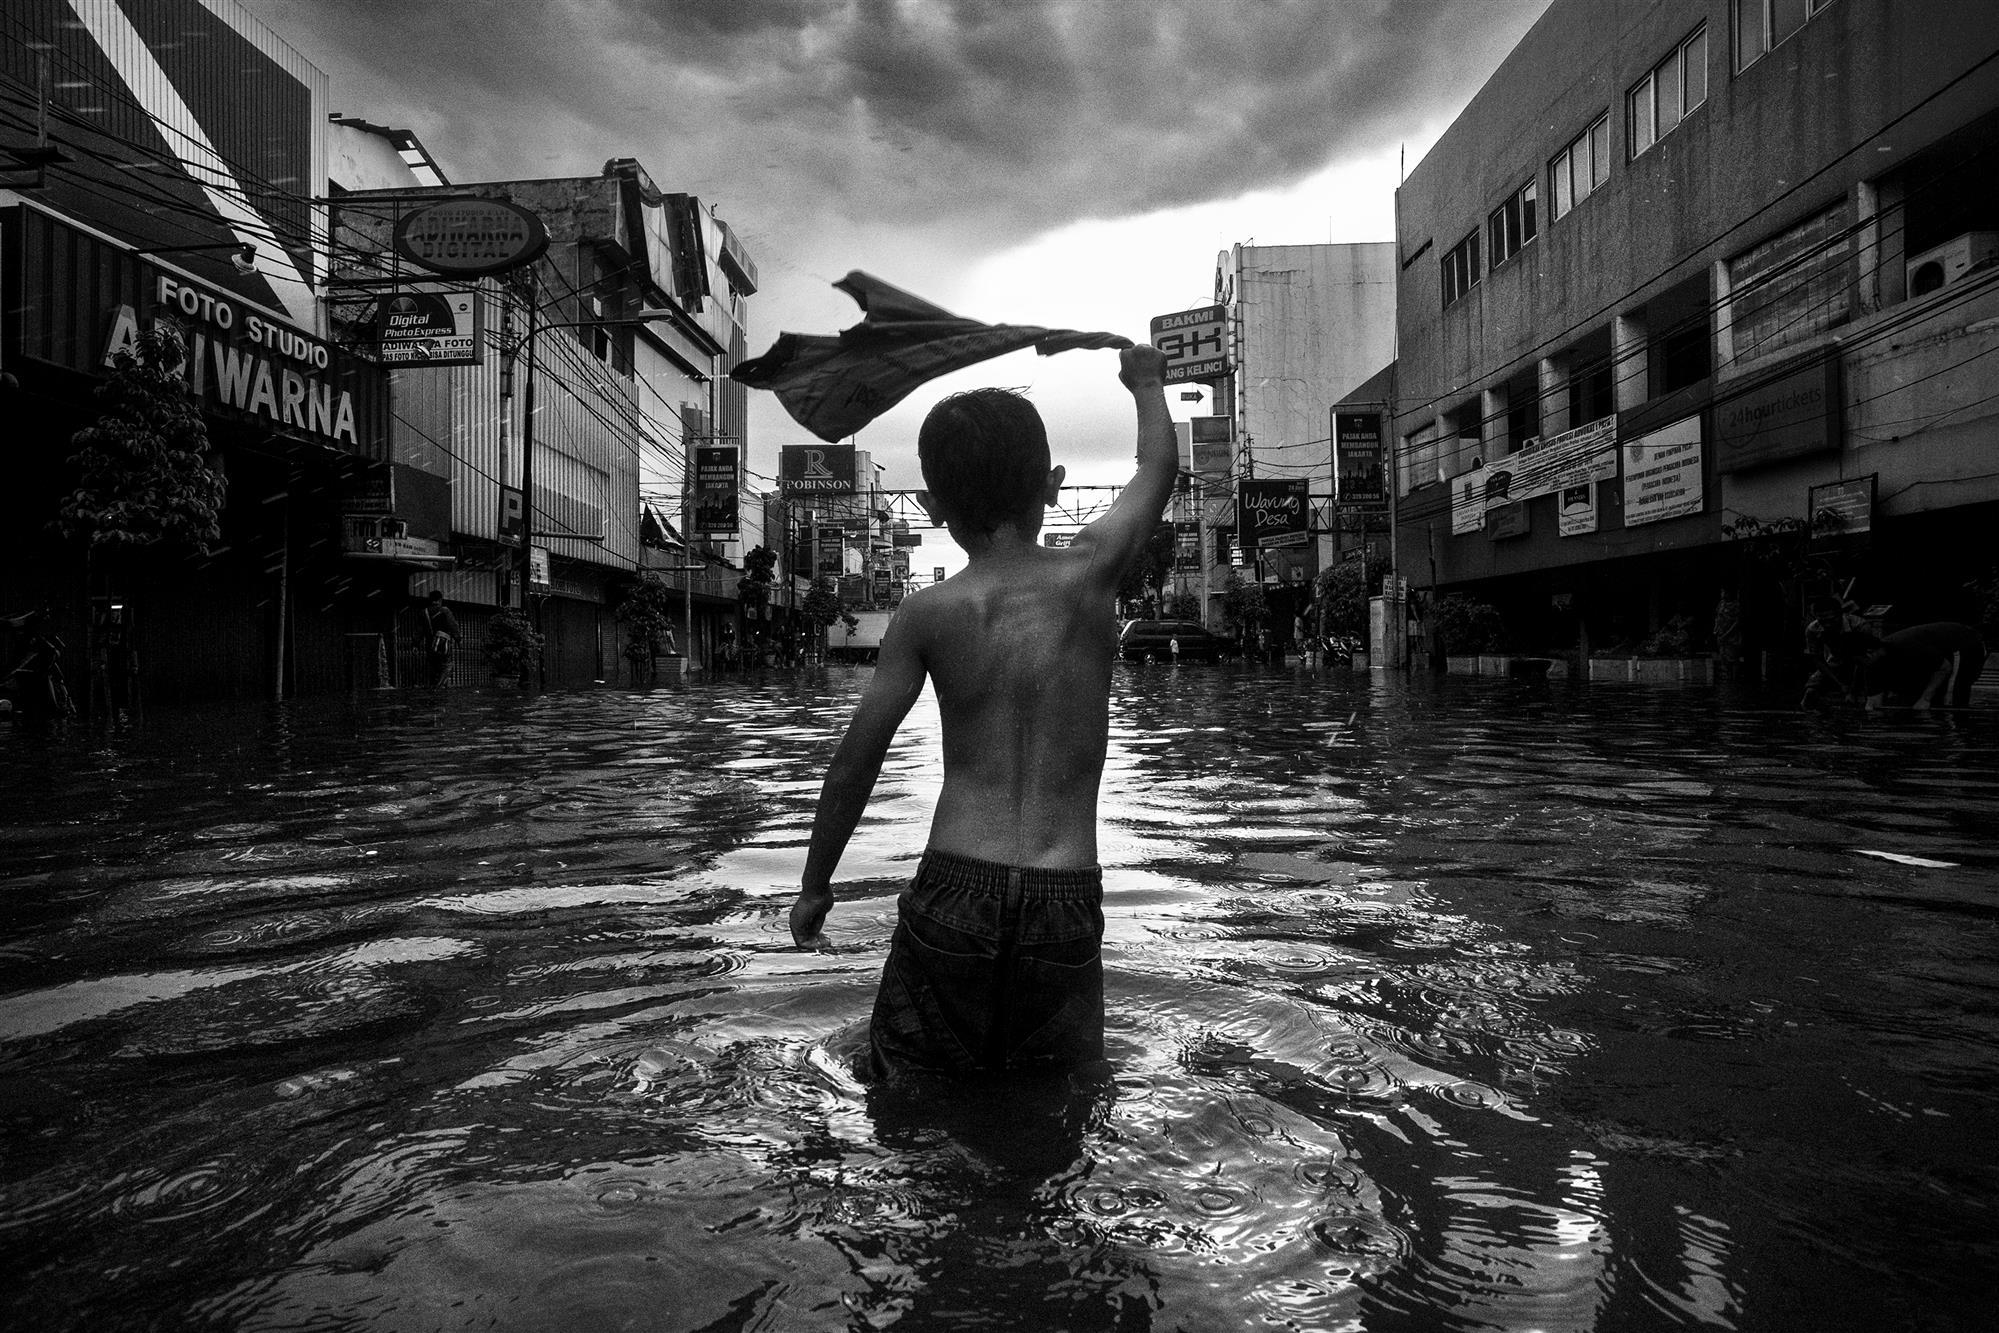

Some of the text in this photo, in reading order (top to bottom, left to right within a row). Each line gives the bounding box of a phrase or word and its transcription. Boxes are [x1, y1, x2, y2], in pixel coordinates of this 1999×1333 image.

[157, 275, 329, 370] FOTO STUDIO
[390, 314, 430, 328] Digital
[1162, 310, 1214, 329] BAKMI
[445, 339, 473, 348] FOTO
[1165, 361, 1222, 380] ANG KELINCI
[804, 449, 834, 475] R
[502, 488, 522, 528] P
[1245, 491, 1300, 515] Warung
[1254, 509, 1291, 528] Desa
[935, 568, 943, 580] P
